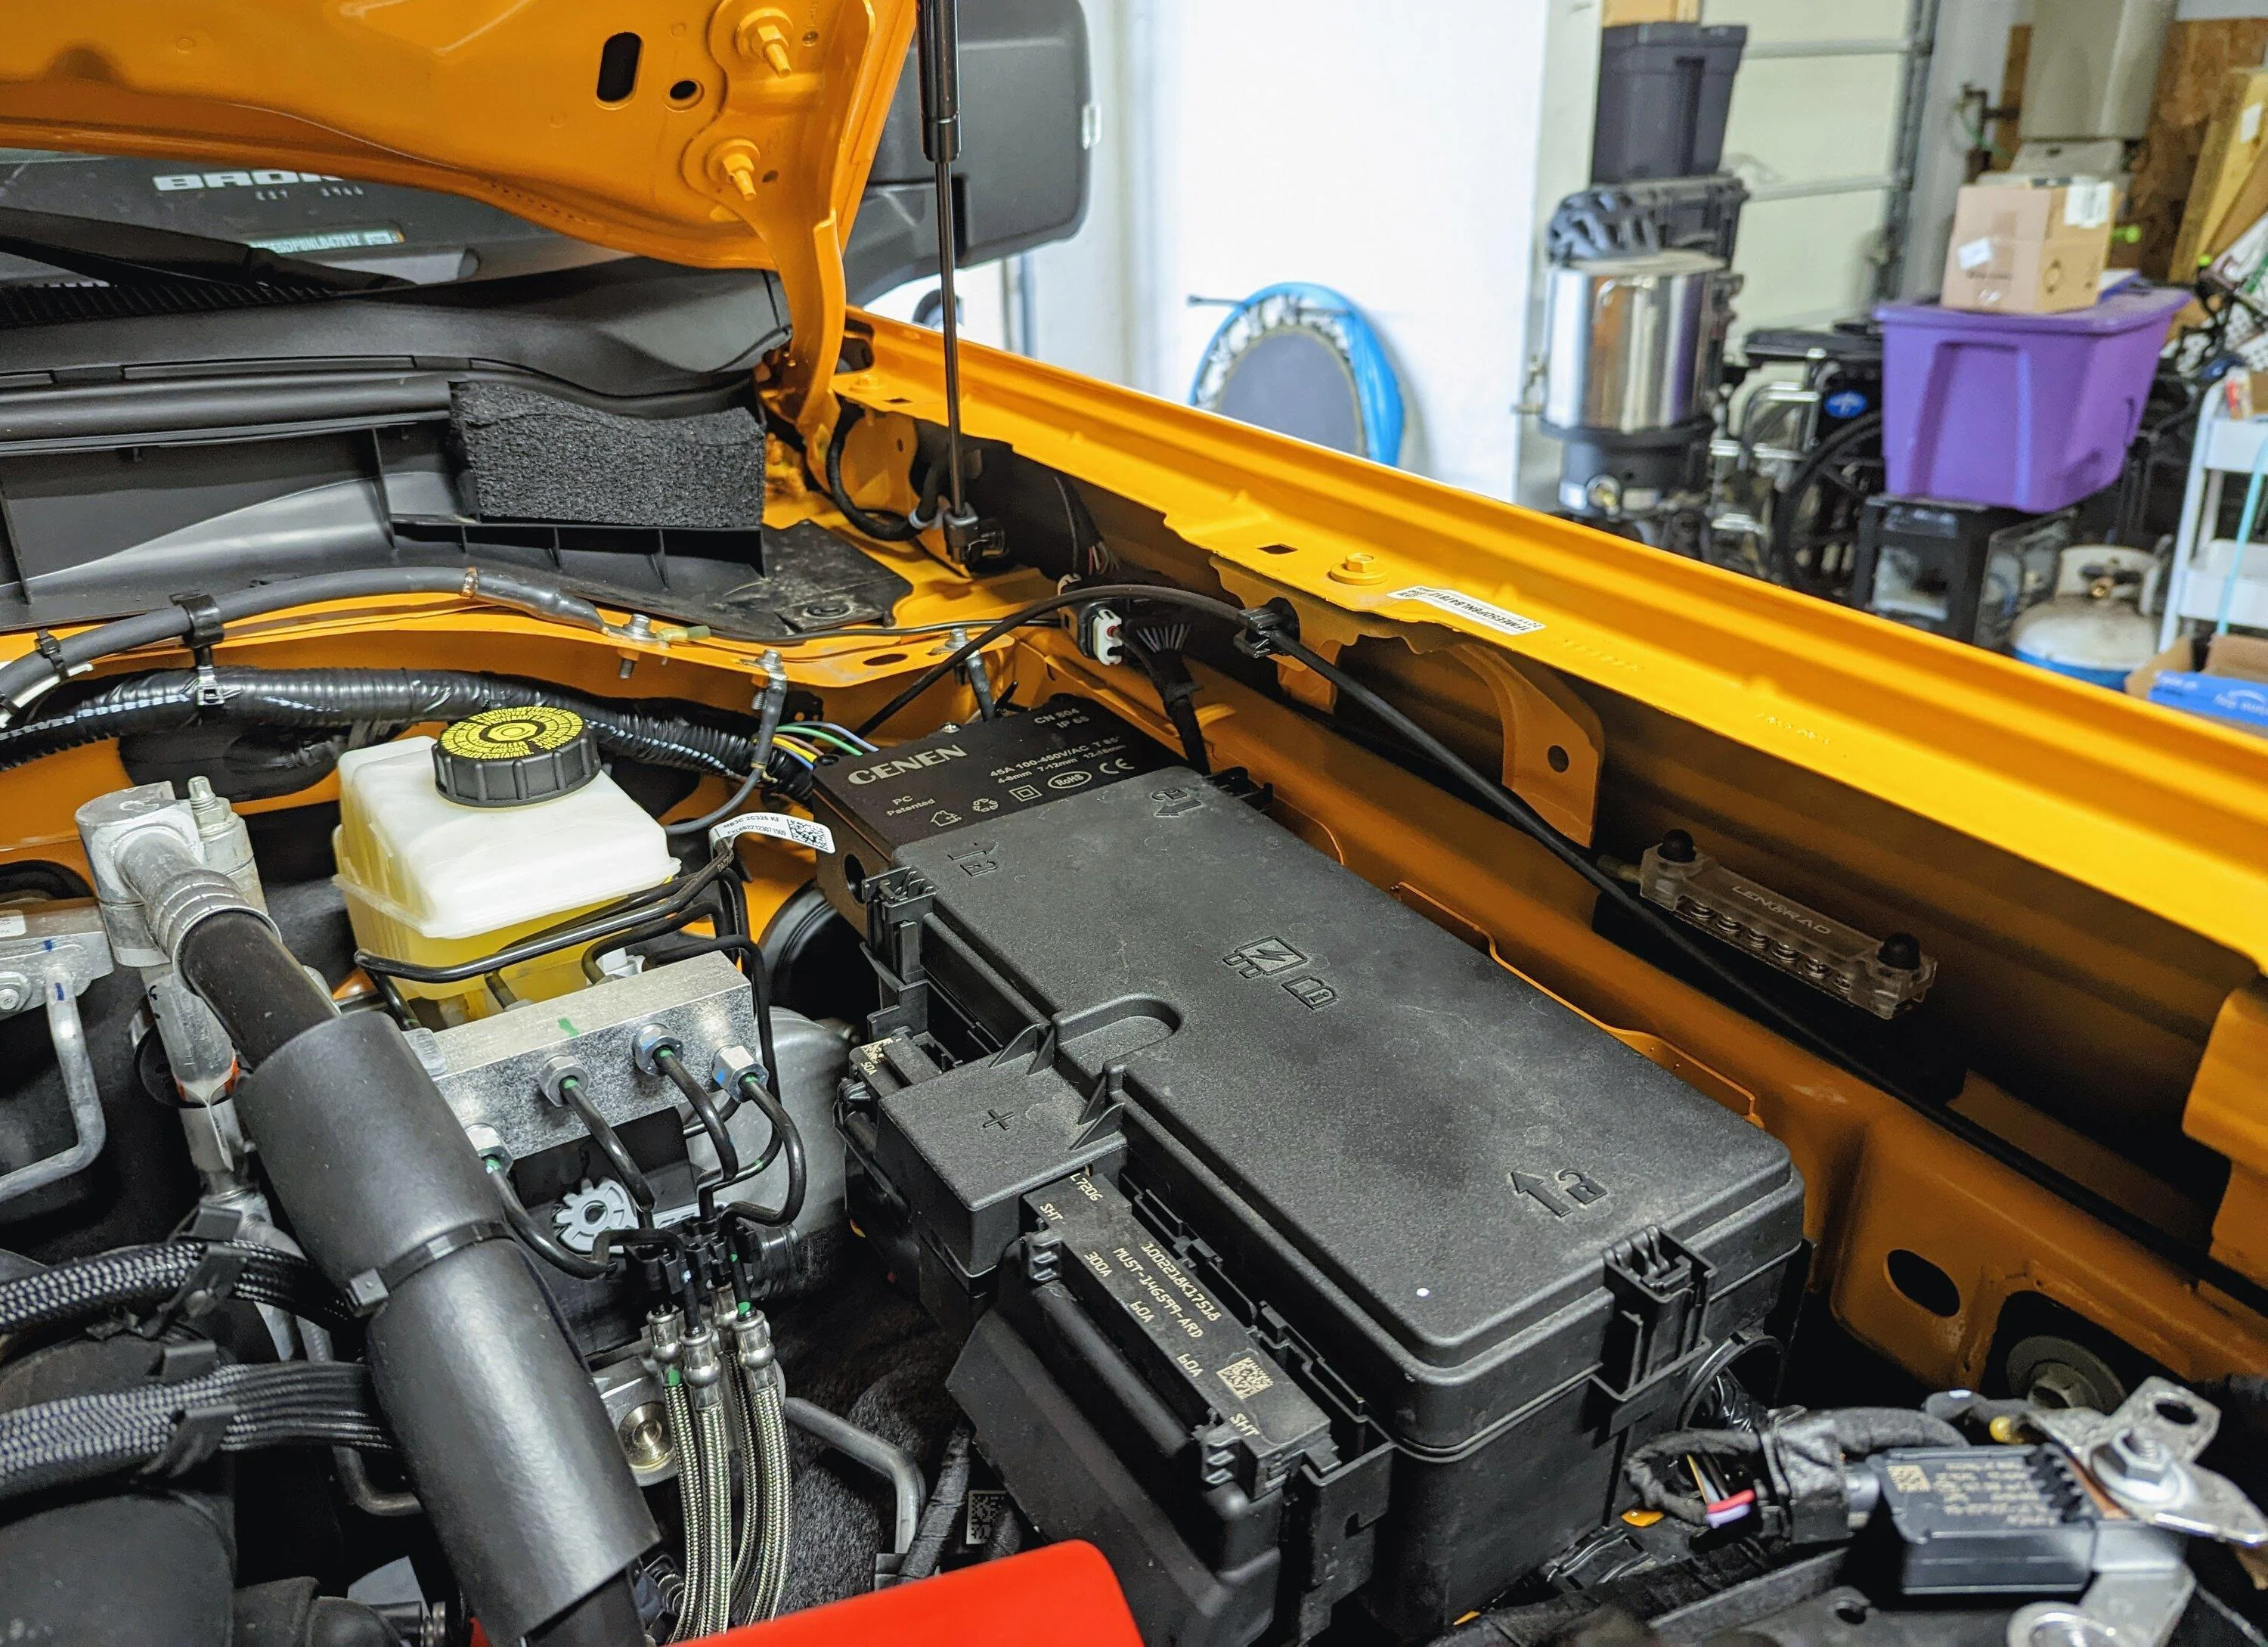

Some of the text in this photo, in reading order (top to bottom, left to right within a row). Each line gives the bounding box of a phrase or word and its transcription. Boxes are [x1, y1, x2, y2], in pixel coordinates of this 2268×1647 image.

[847, 744, 968, 785] CENEN
[990, 765, 1015, 777] 45A
[1037, 758, 1079, 772] 7-12mm
[1054, 774, 1085, 787] RoHS
[886, 798, 937, 817] Patented
[892, 796, 913, 806] PC
[860, 1061, 878, 1076] 50A
[1040, 1202, 1063, 1221] SHT
[1084, 1251, 1204, 1378] 300A 60A 60A
[1229, 1413, 1260, 1437] SHT
